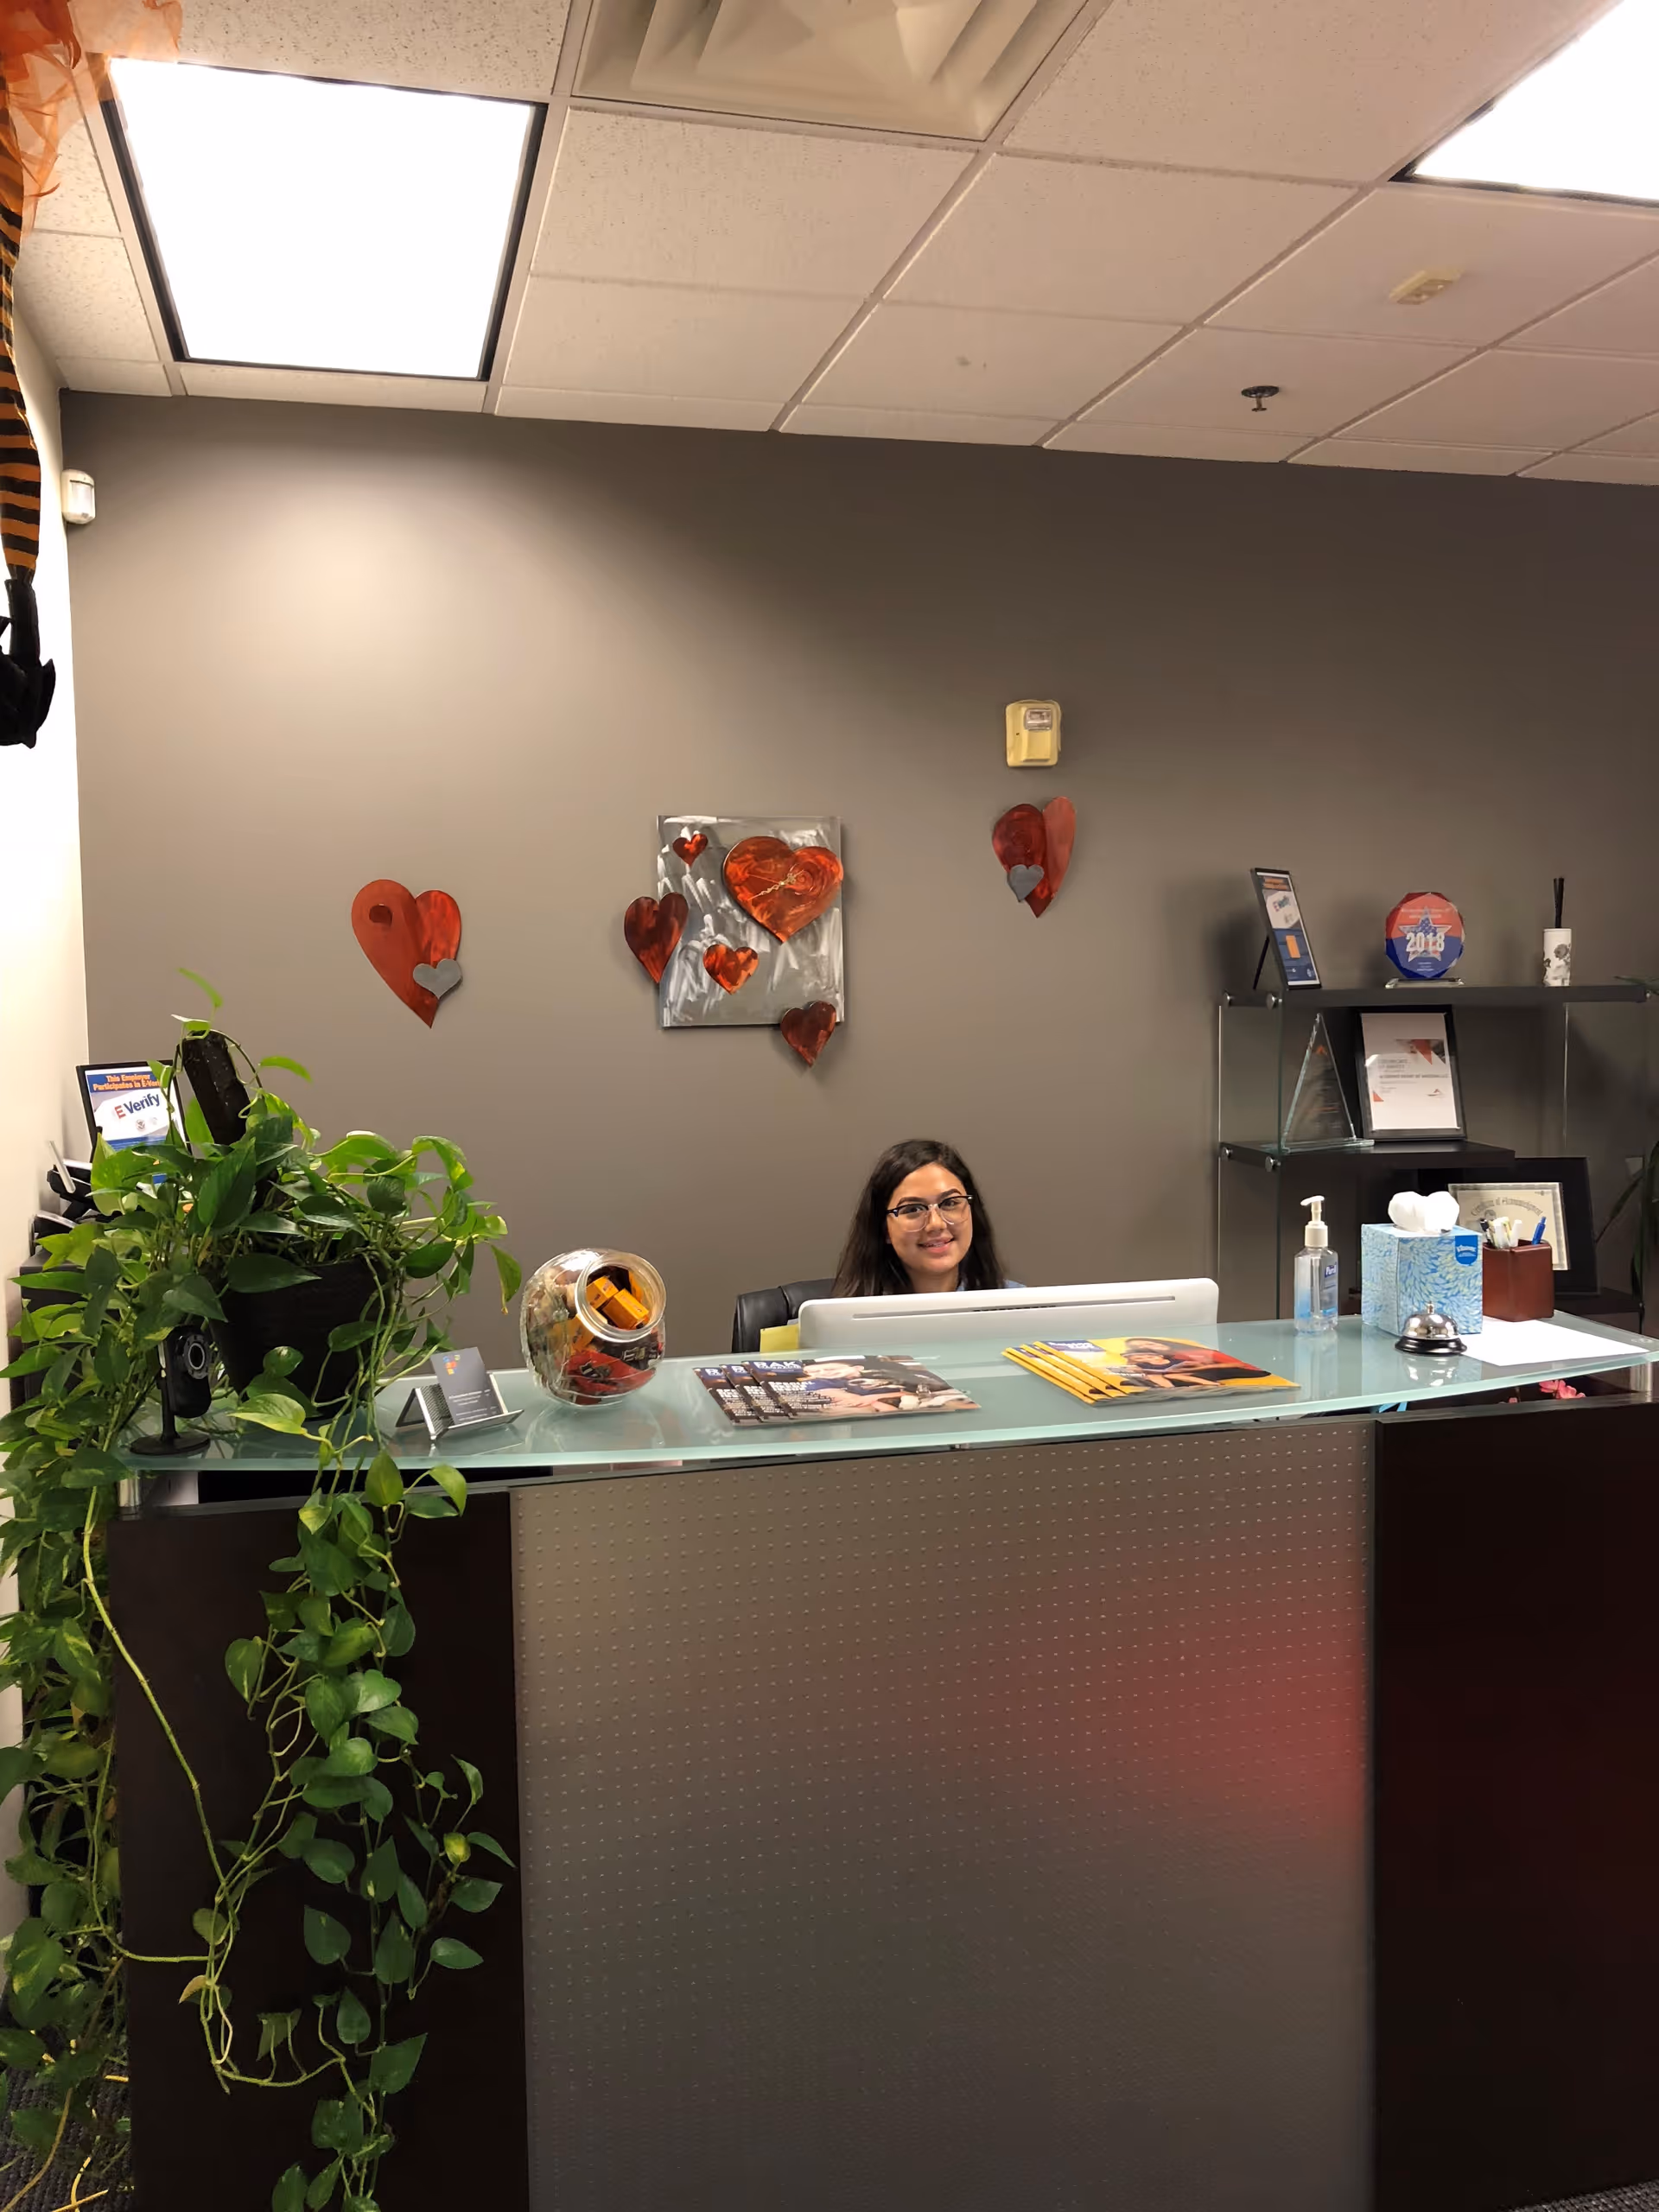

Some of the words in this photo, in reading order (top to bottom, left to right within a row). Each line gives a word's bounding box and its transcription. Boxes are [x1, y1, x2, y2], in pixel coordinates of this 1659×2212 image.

[1406, 932, 1445, 952] 2018
[92, 1081, 133, 1090] Participates
[123, 1093, 160, 1115] Verify
